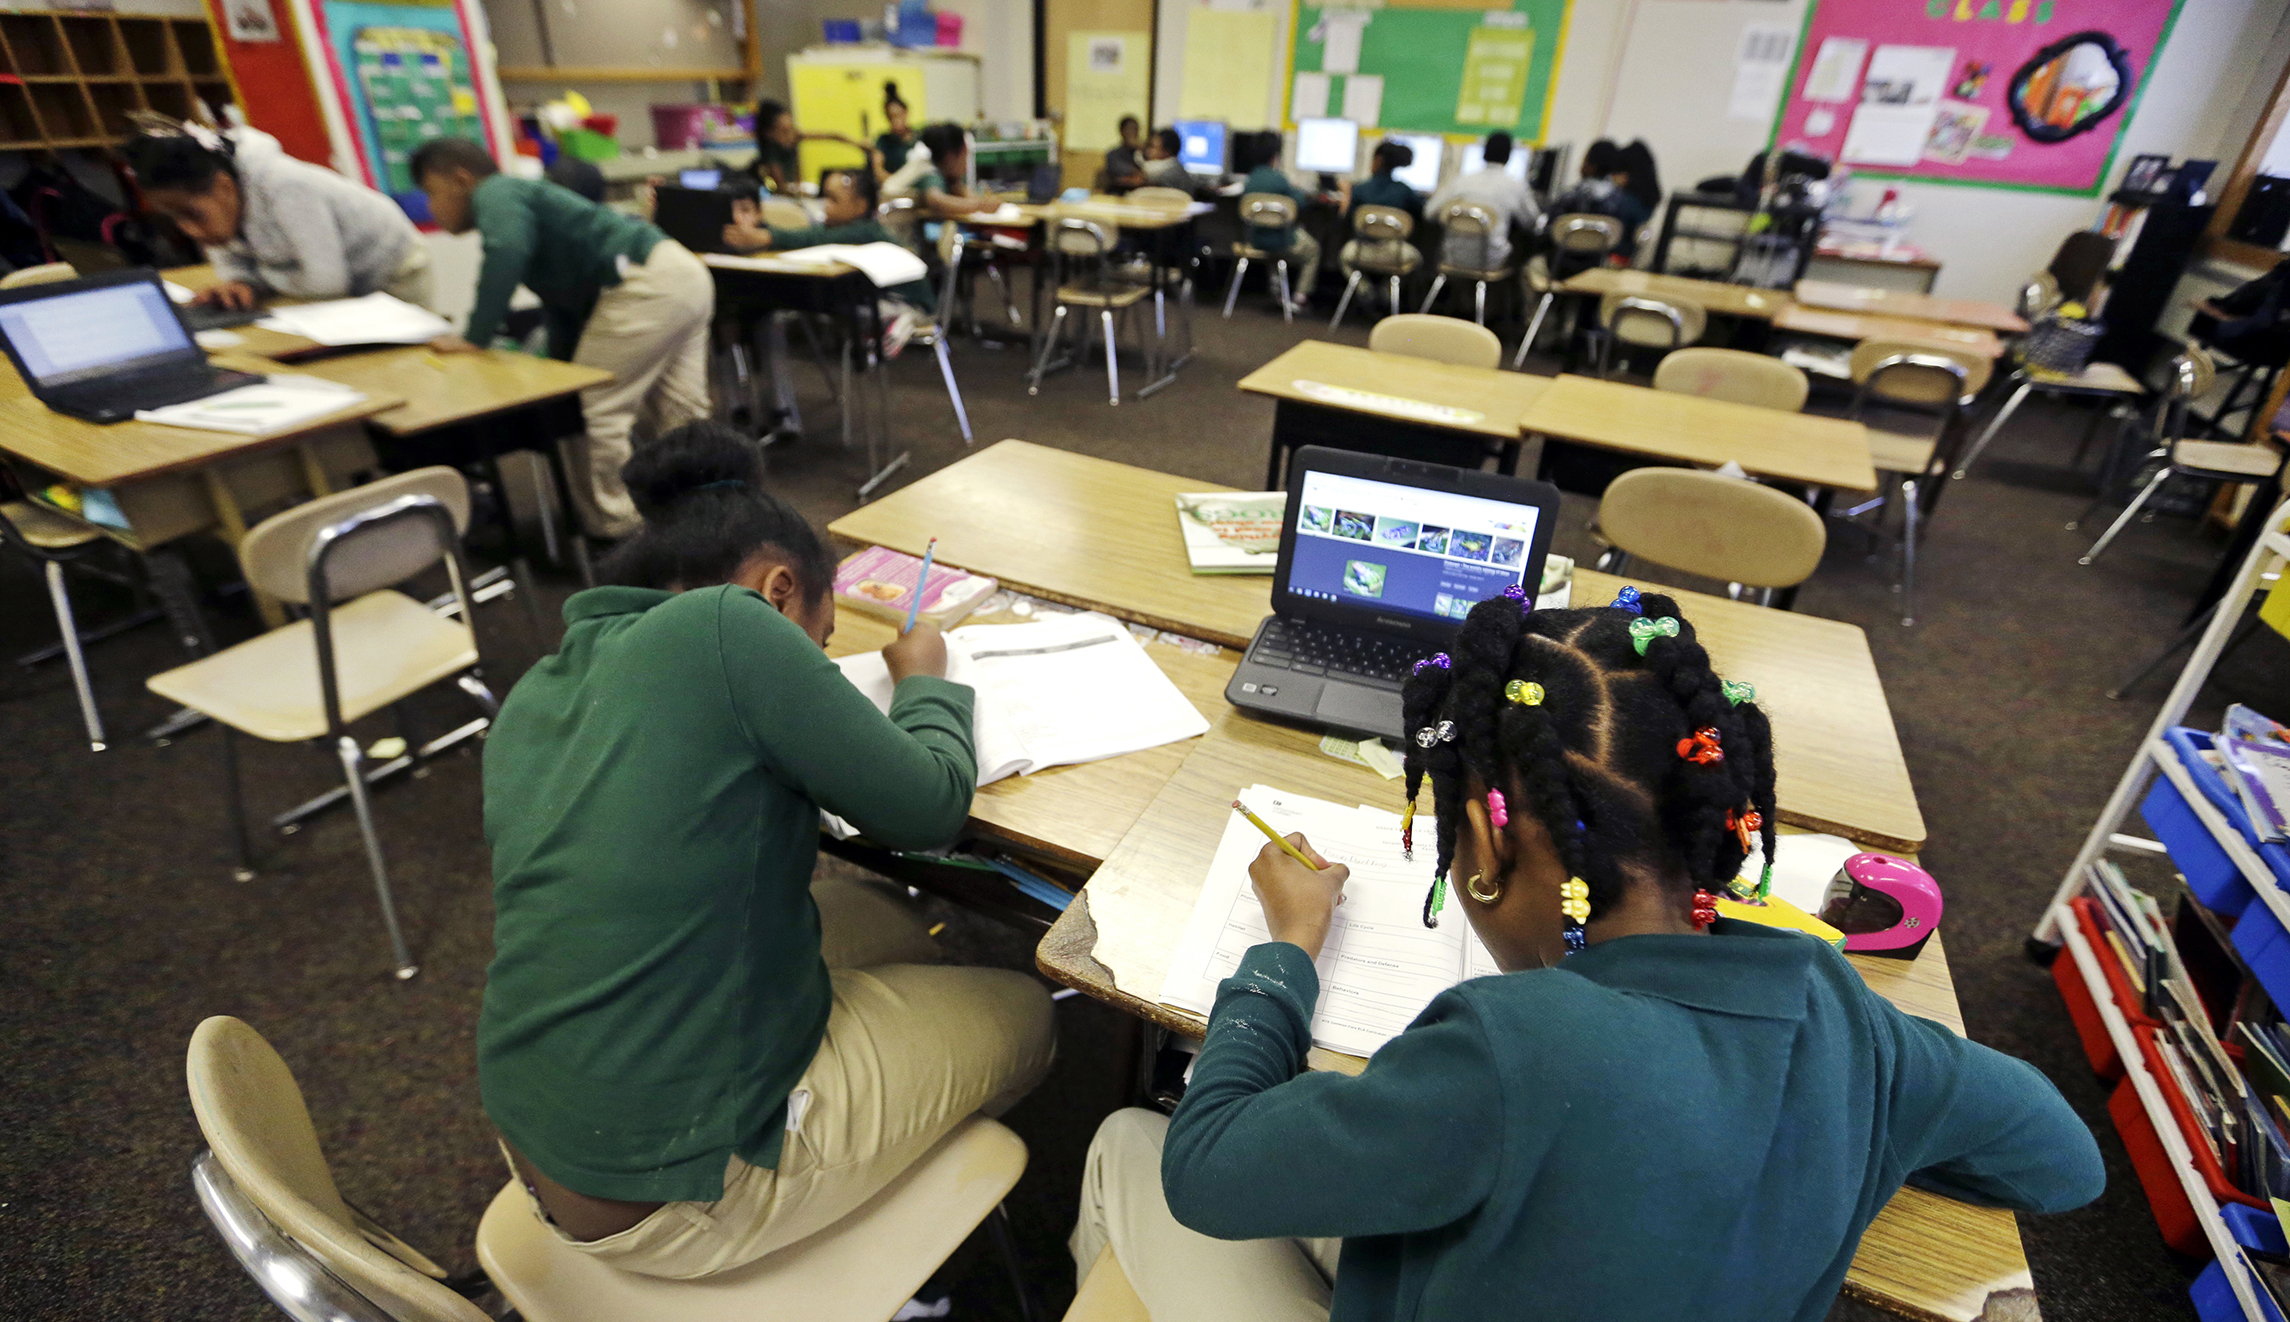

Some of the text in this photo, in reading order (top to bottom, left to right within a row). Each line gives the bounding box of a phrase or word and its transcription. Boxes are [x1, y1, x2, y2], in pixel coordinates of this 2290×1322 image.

[1925, 0, 2056, 24] CLASS
[1228, 923, 1246, 931] Habitat
[1360, 924, 1375, 932] Cycle
[1340, 954, 1366, 964] Predators
[1377, 961, 1400, 969] Defense
[1332, 985, 1360, 996] Behaviors
